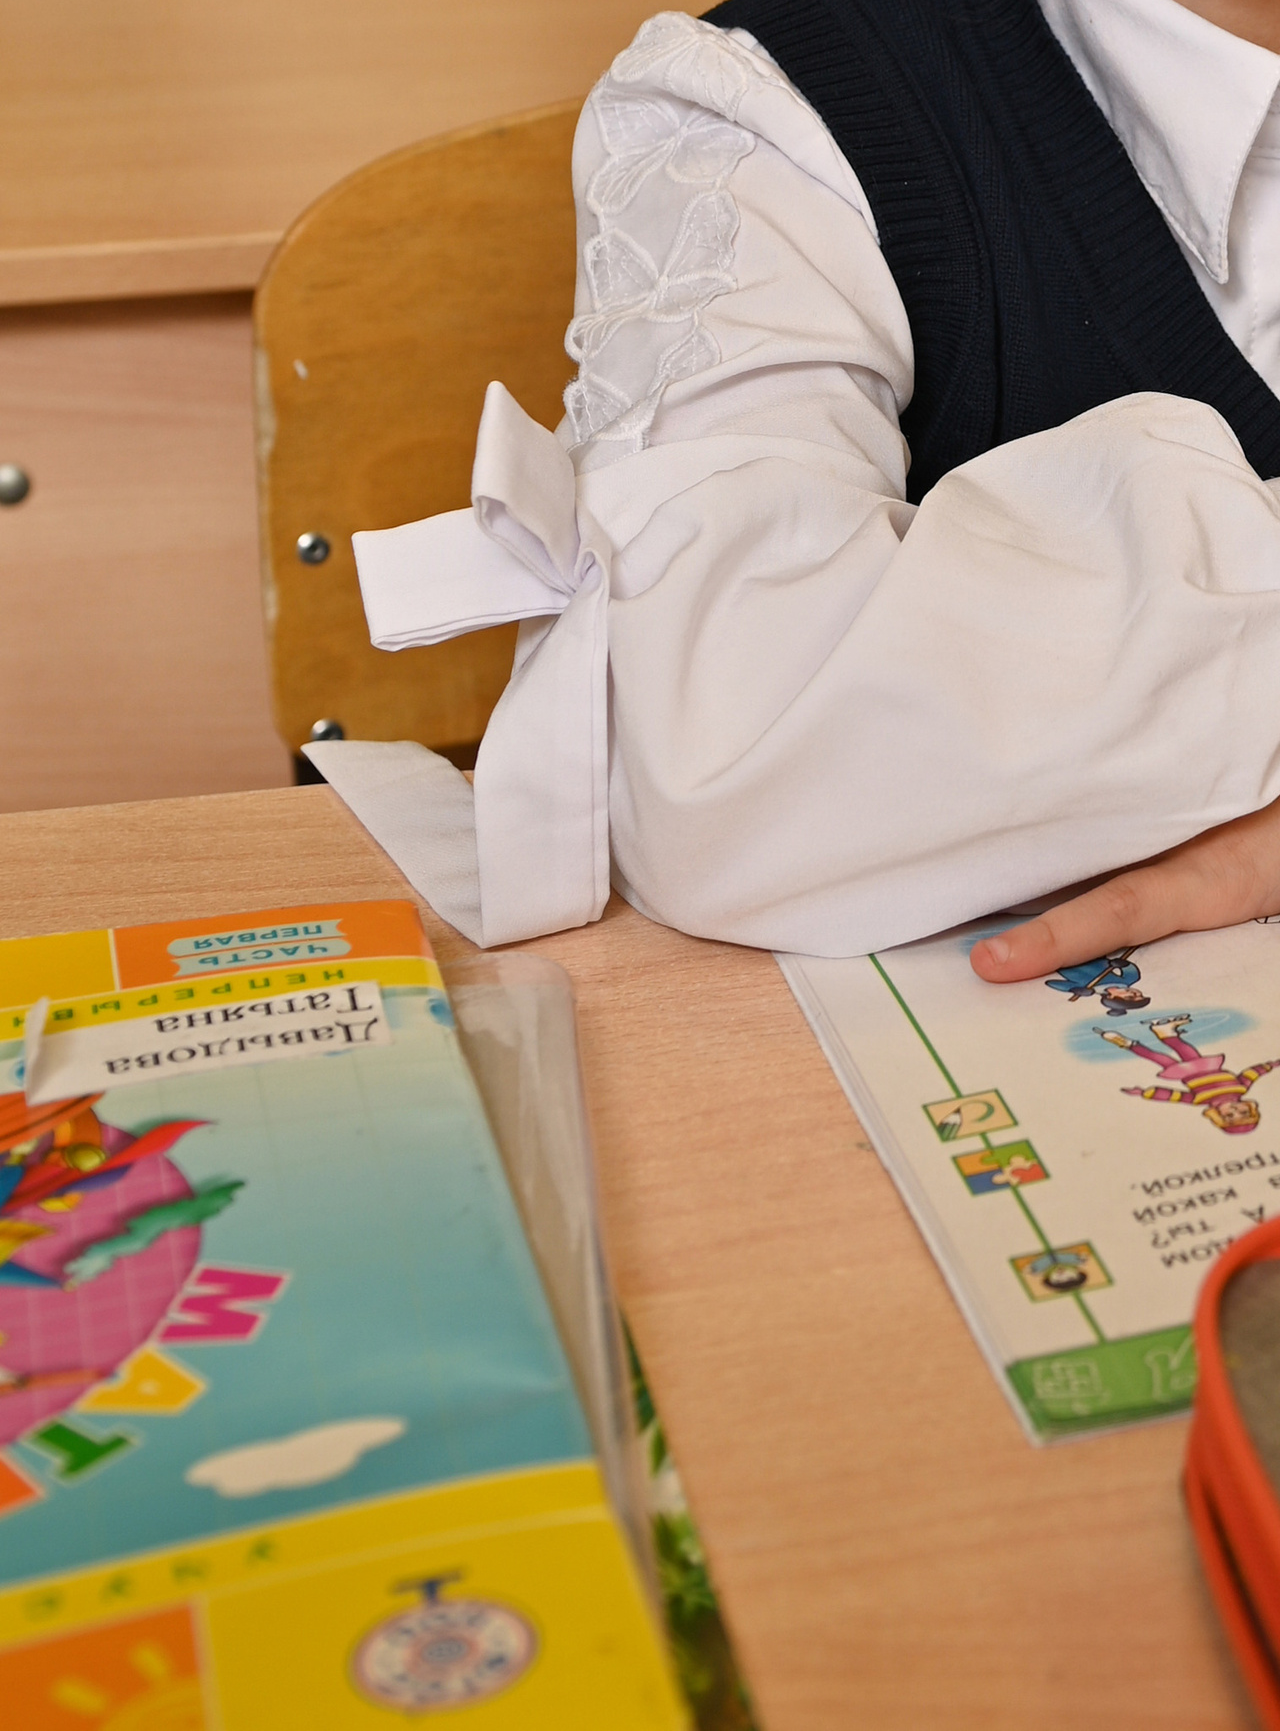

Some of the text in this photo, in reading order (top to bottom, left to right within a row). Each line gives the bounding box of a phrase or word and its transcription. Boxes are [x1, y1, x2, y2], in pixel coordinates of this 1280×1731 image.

[193, 923, 324, 950] ПЕРВАЯ
[197, 943, 329, 969] ЧАСТЬ
[152, 985, 374, 1035] Татьяна
[103, 1017, 381, 1076] Давыдова
[1130, 1187, 1238, 1227] какой
[1239, 1204, 1266, 1224] А
[1151, 1219, 1216, 1249] ты?
